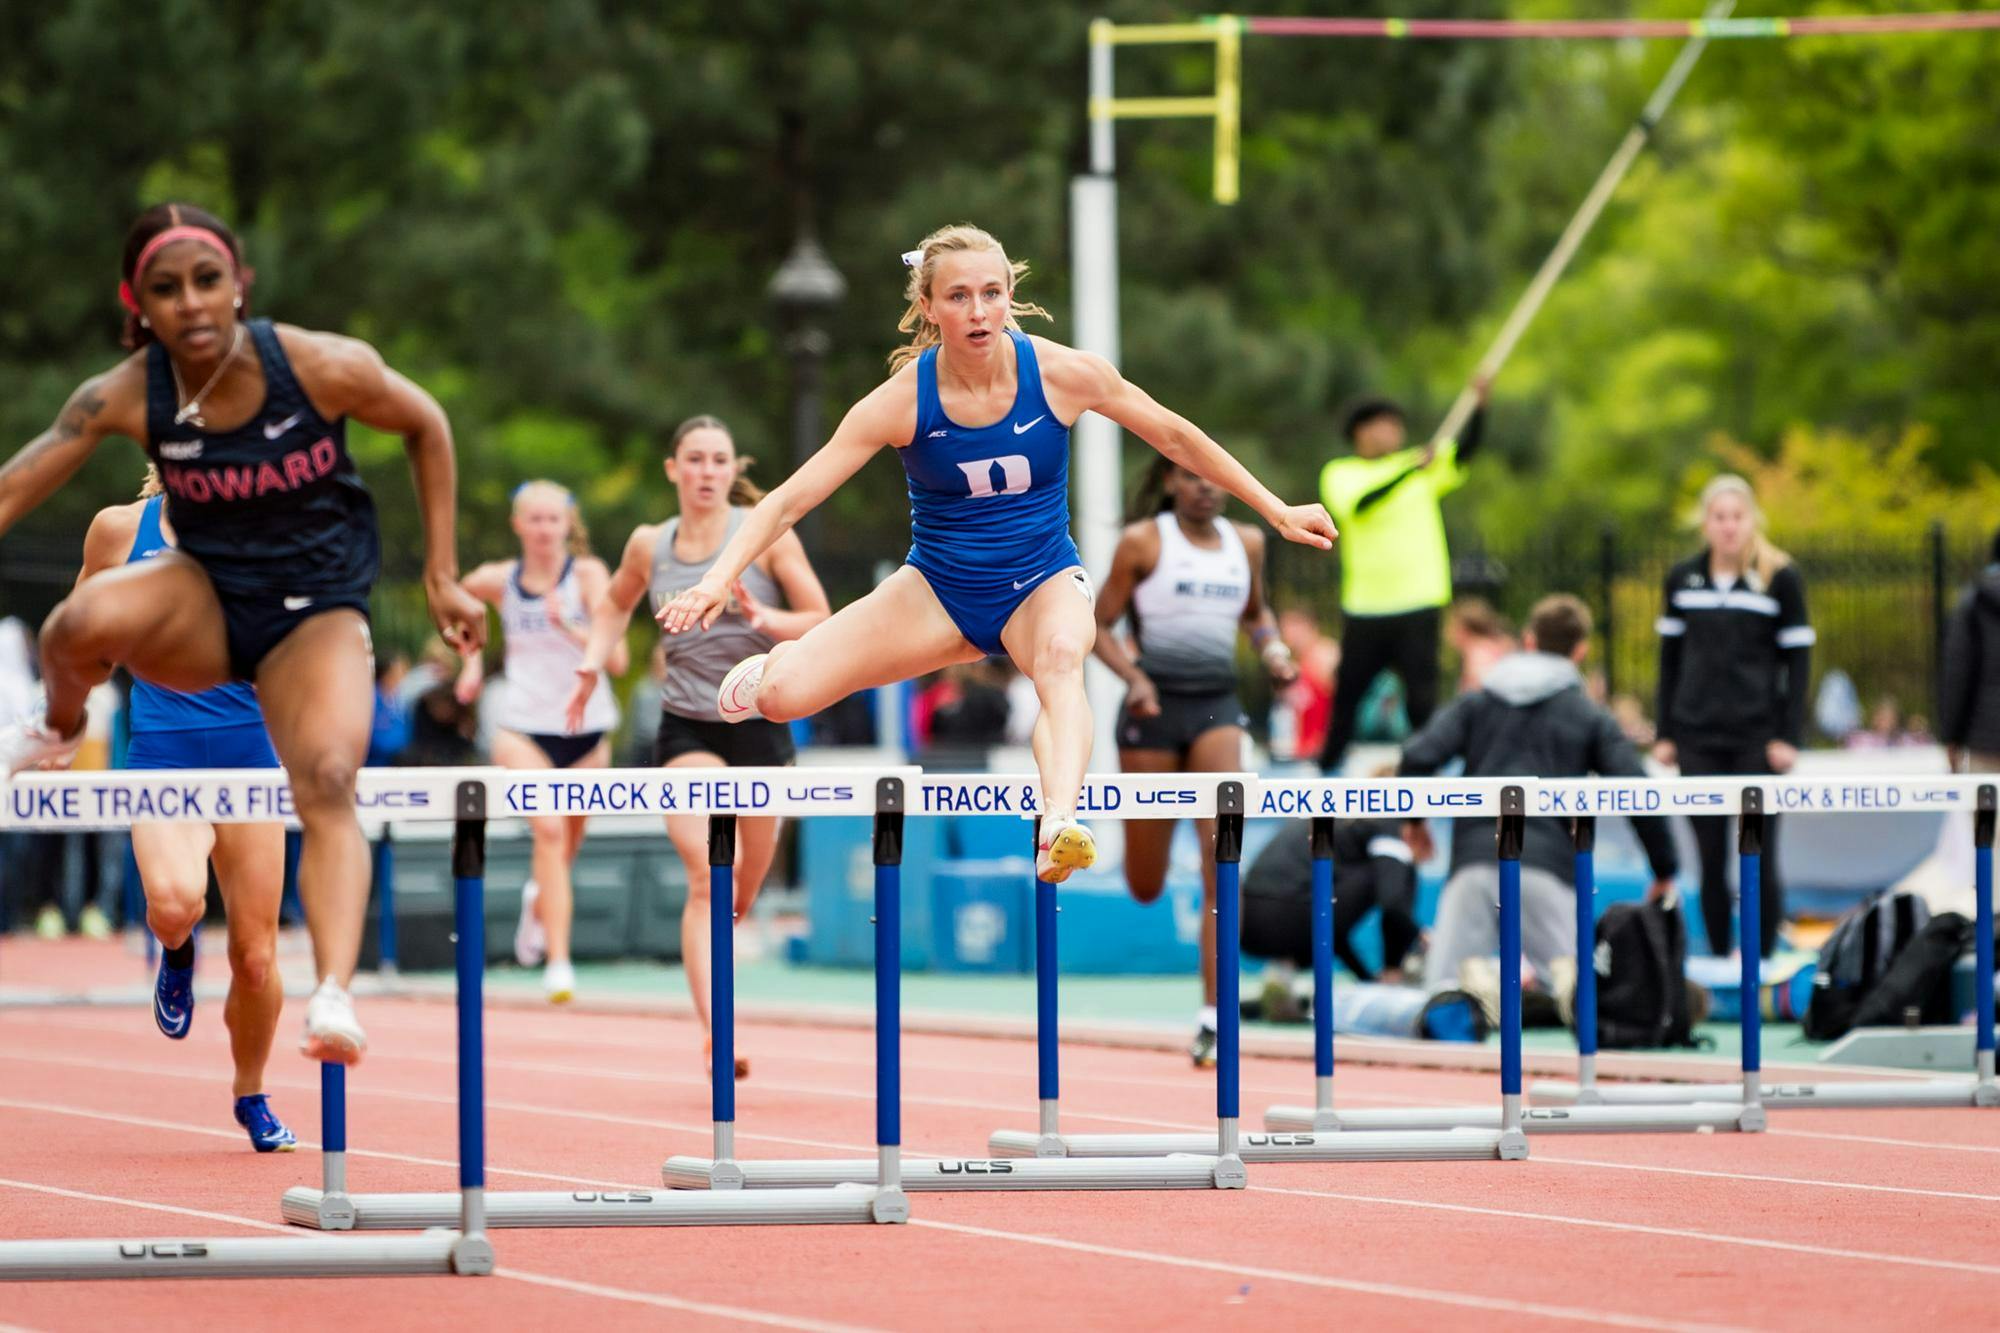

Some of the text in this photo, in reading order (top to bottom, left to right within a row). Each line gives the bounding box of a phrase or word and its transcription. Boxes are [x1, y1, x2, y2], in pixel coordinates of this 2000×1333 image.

[163, 436, 337, 503] HOWARD
[6, 786, 80, 819] UKE
[93, 787, 203, 818] TRACK
[214, 786, 235, 817] &
[356, 791, 430, 807] UCS
[548, 783, 649, 811] TRACK
[659, 782, 678, 809] &
[688, 782, 770, 809] FIELD
[787, 786, 854, 801] UCS
[921, 785, 1012, 812] TRACK
[1020, 785, 1038, 812] &
[1136, 790, 1198, 804] UCS
[1321, 789, 1337, 813] &
[1345, 789, 1414, 813] FIELD
[1427, 793, 1483, 806] UCS
[1575, 789, 1588, 812] &
[1597, 789, 1661, 812] FIELD
[1672, 793, 1725, 806] UCS
[1821, 786, 1834, 808] &
[1842, 786, 1902, 808] FIELD
[1912, 790, 1962, 802] UCS
[1248, 1134, 1315, 1146] UCS
[937, 1159, 1013, 1174] UCS
[573, 1191, 654, 1203] UCS
[119, 1243, 208, 1259] UCS
